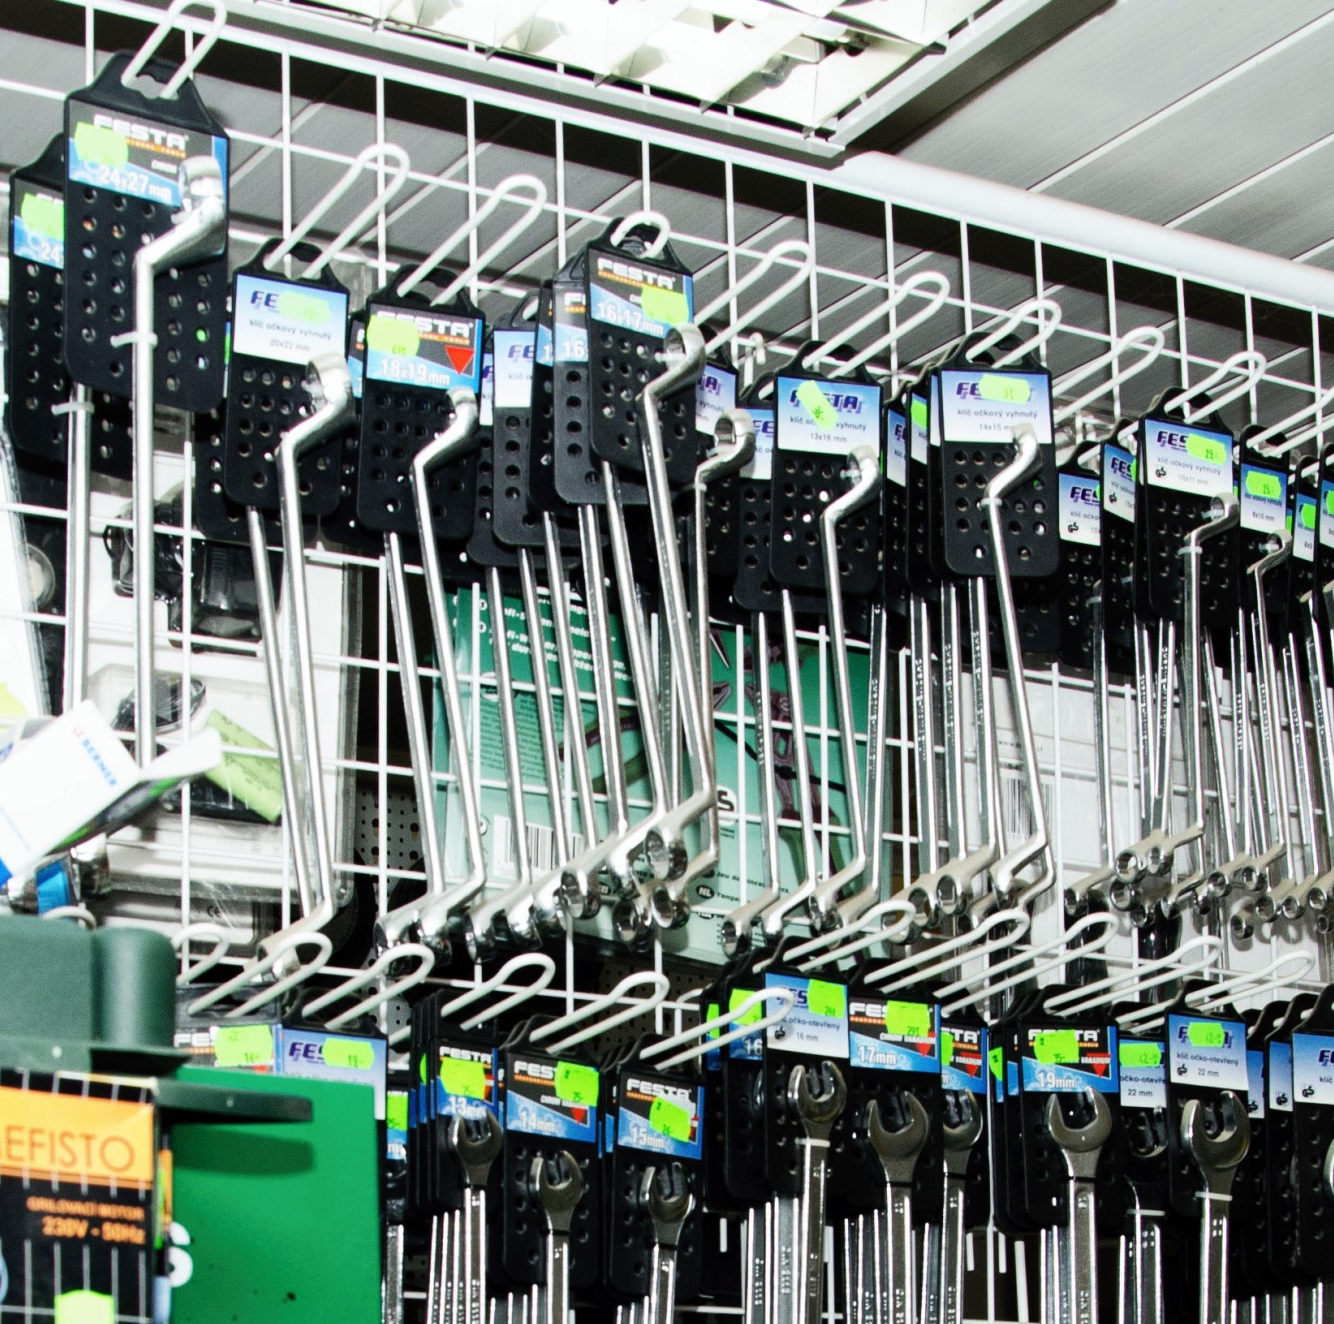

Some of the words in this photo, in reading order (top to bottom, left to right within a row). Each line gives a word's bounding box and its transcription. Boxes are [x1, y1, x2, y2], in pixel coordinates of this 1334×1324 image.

[598, 257, 674, 290] FESTA
[597, 301, 664, 336] 16x17mm
[380, 357, 451, 387] 18x19mm
[439, 1046, 492, 1064] FESTA
[858, 1046, 898, 1065] 17mm
[1037, 1071, 1075, 1090] 19mm
[519, 1110, 556, 1133] 14mm
[630, 1126, 665, 1148] 15mm
[42, 1216, 90, 1238] 230V
